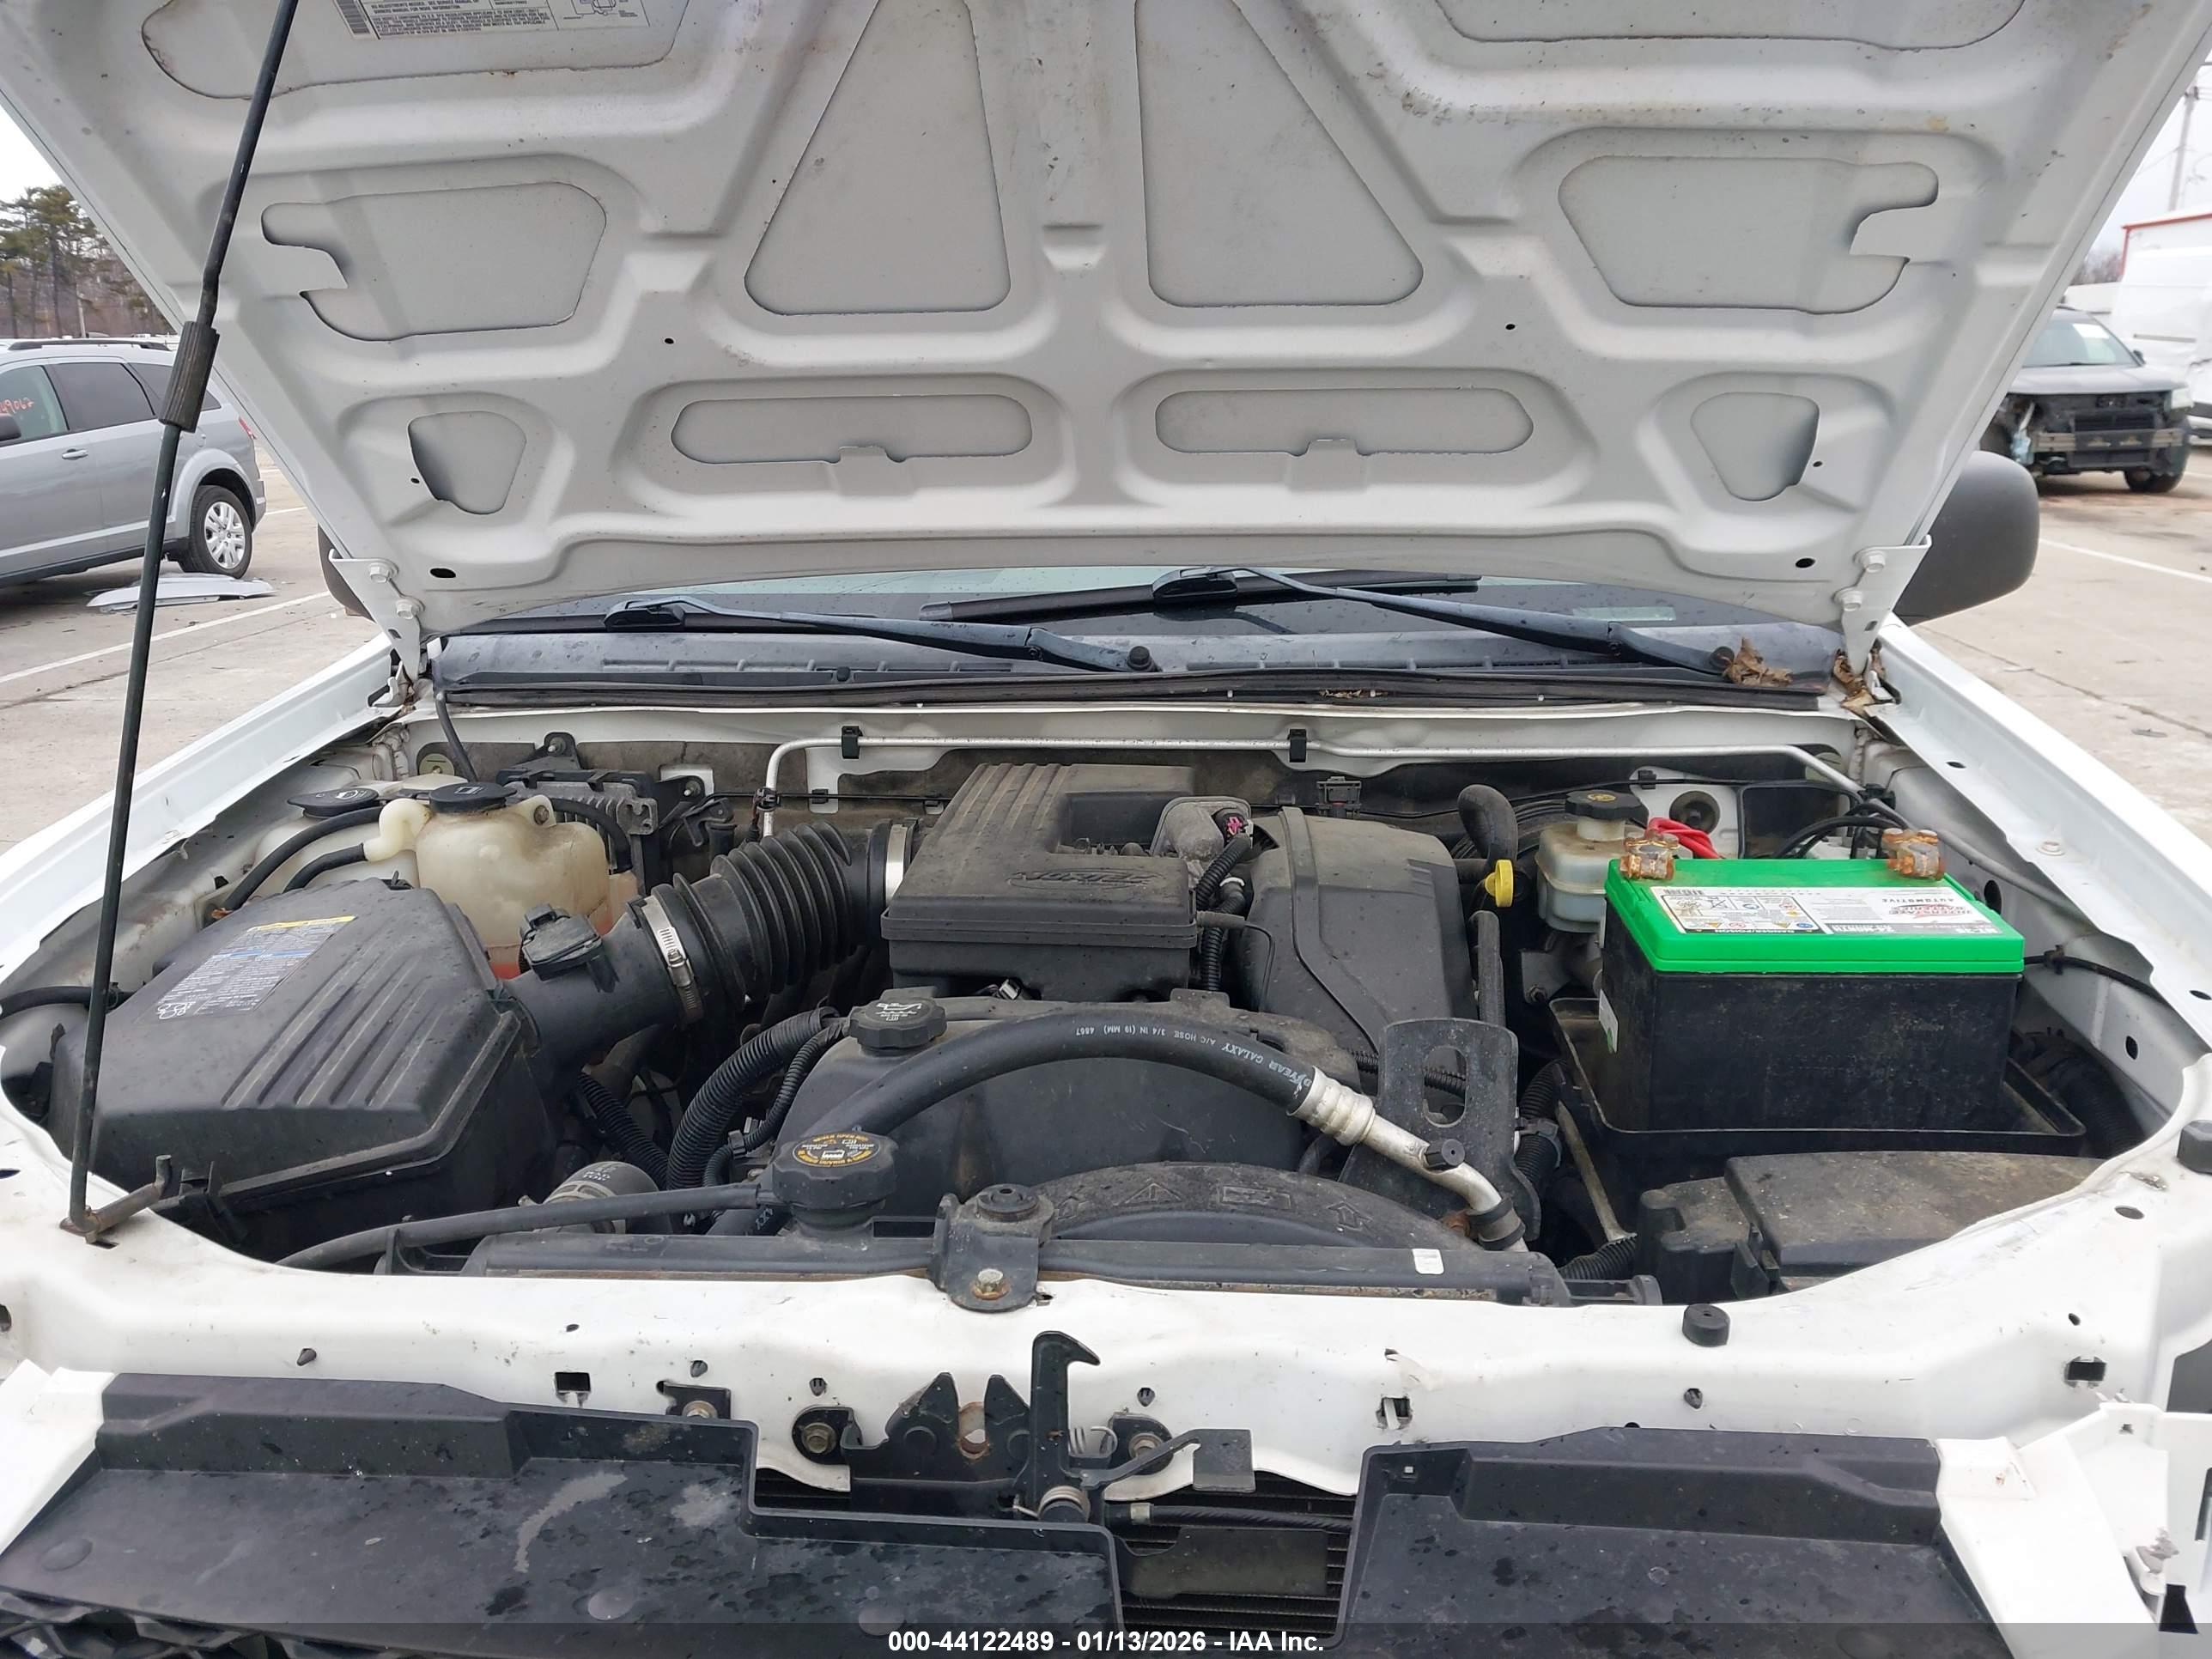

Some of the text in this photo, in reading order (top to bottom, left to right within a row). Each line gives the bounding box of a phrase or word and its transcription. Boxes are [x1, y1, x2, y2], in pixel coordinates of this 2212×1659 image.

[1139, 1026, 1149, 1035] IN
[1152, 1027, 1167, 1036] 3/4
[1173, 1030, 1197, 1042] HOSE
[1200, 1036, 1217, 1046] A/C
[1221, 1042, 1264, 1064] GALAXY
